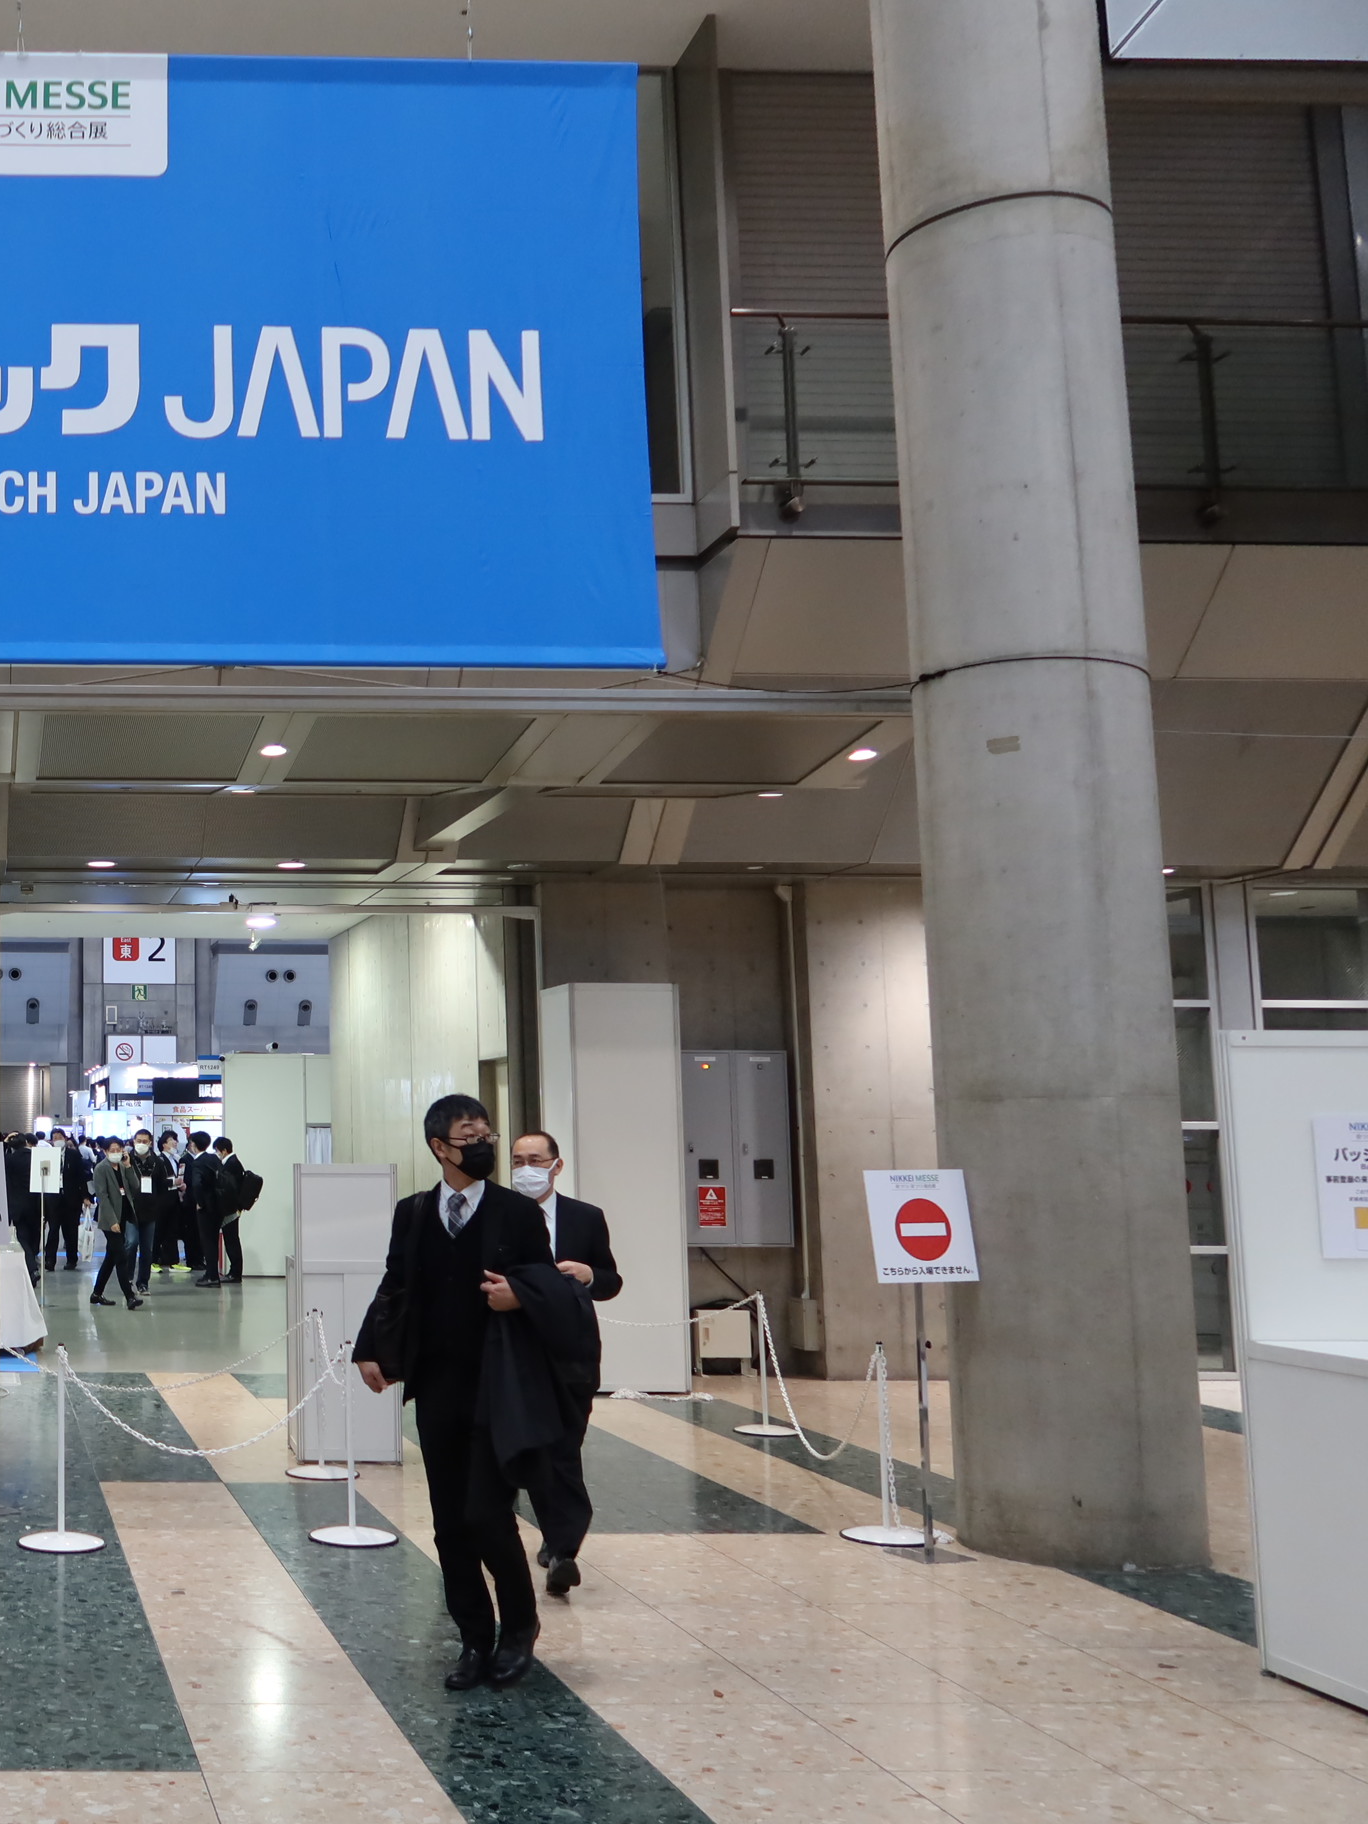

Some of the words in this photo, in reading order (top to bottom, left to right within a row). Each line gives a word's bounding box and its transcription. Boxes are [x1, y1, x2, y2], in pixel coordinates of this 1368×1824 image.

[6, 80, 131, 110] MESSE
[164, 325, 543, 441] JAPAN
[74, 472, 225, 514] JAPAN
[120, 944, 132, 959] 東
[148, 937, 166, 961] 2
[889, 1174, 914, 1182] NIKKEI
[915, 1174, 940, 1182] MESSE
[882, 1265, 974, 1276] こちらから入場できません。
